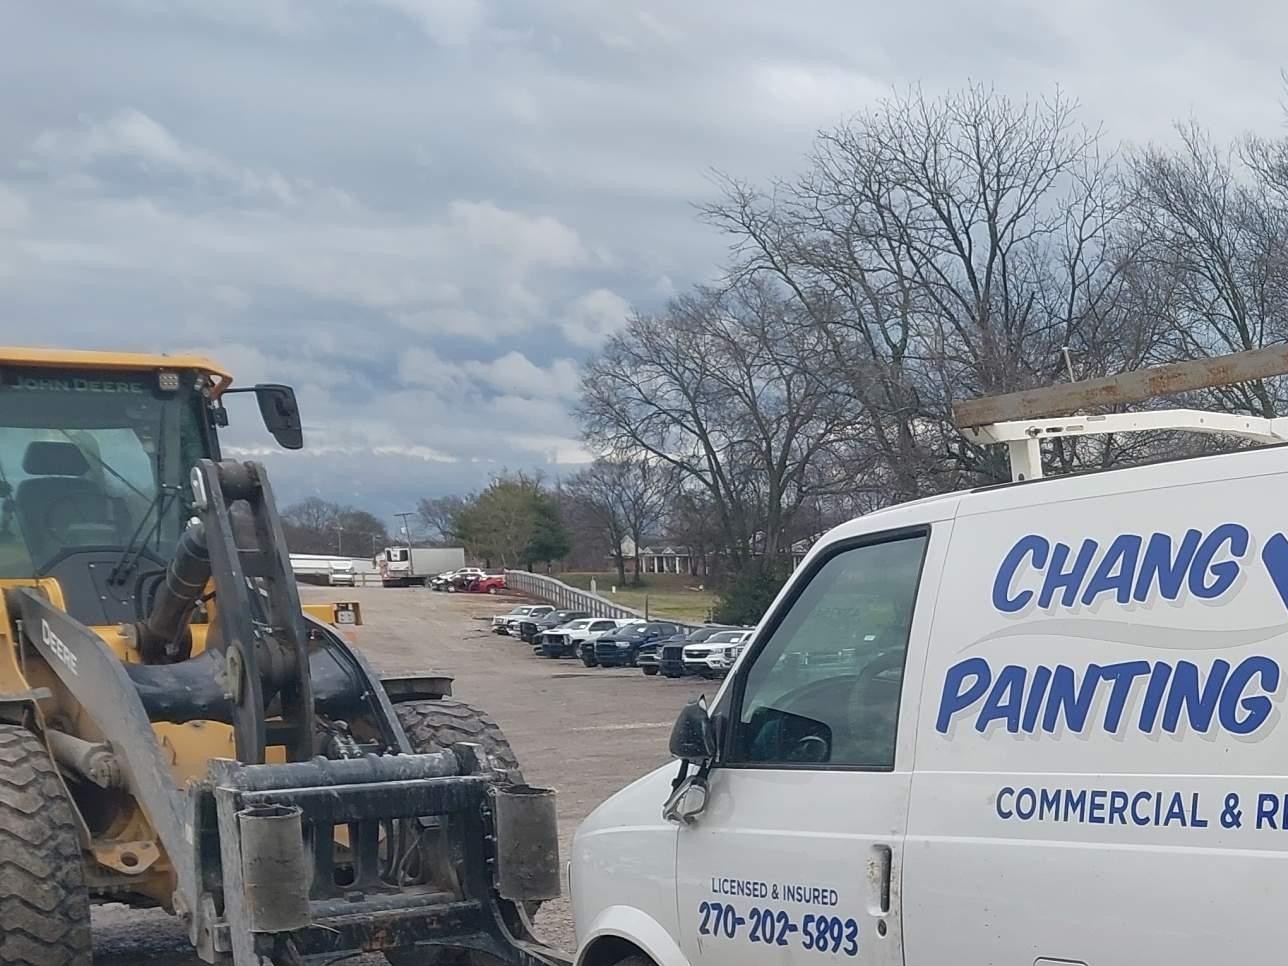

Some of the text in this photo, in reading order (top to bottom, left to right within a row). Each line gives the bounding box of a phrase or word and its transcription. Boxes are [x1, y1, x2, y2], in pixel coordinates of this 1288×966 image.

[74, 379, 143, 393] DEERE
[992, 523, 1249, 612] CHANG
[41, 618, 78, 676] DEERE
[935, 656, 1280, 735] PAINTING
[996, 787, 1208, 827] COMMERCIAL
[1220, 793, 1243, 829] &
[711, 877, 838, 906] LICENSED & INSURED
[699, 901, 858, 956] 270-202-5893
